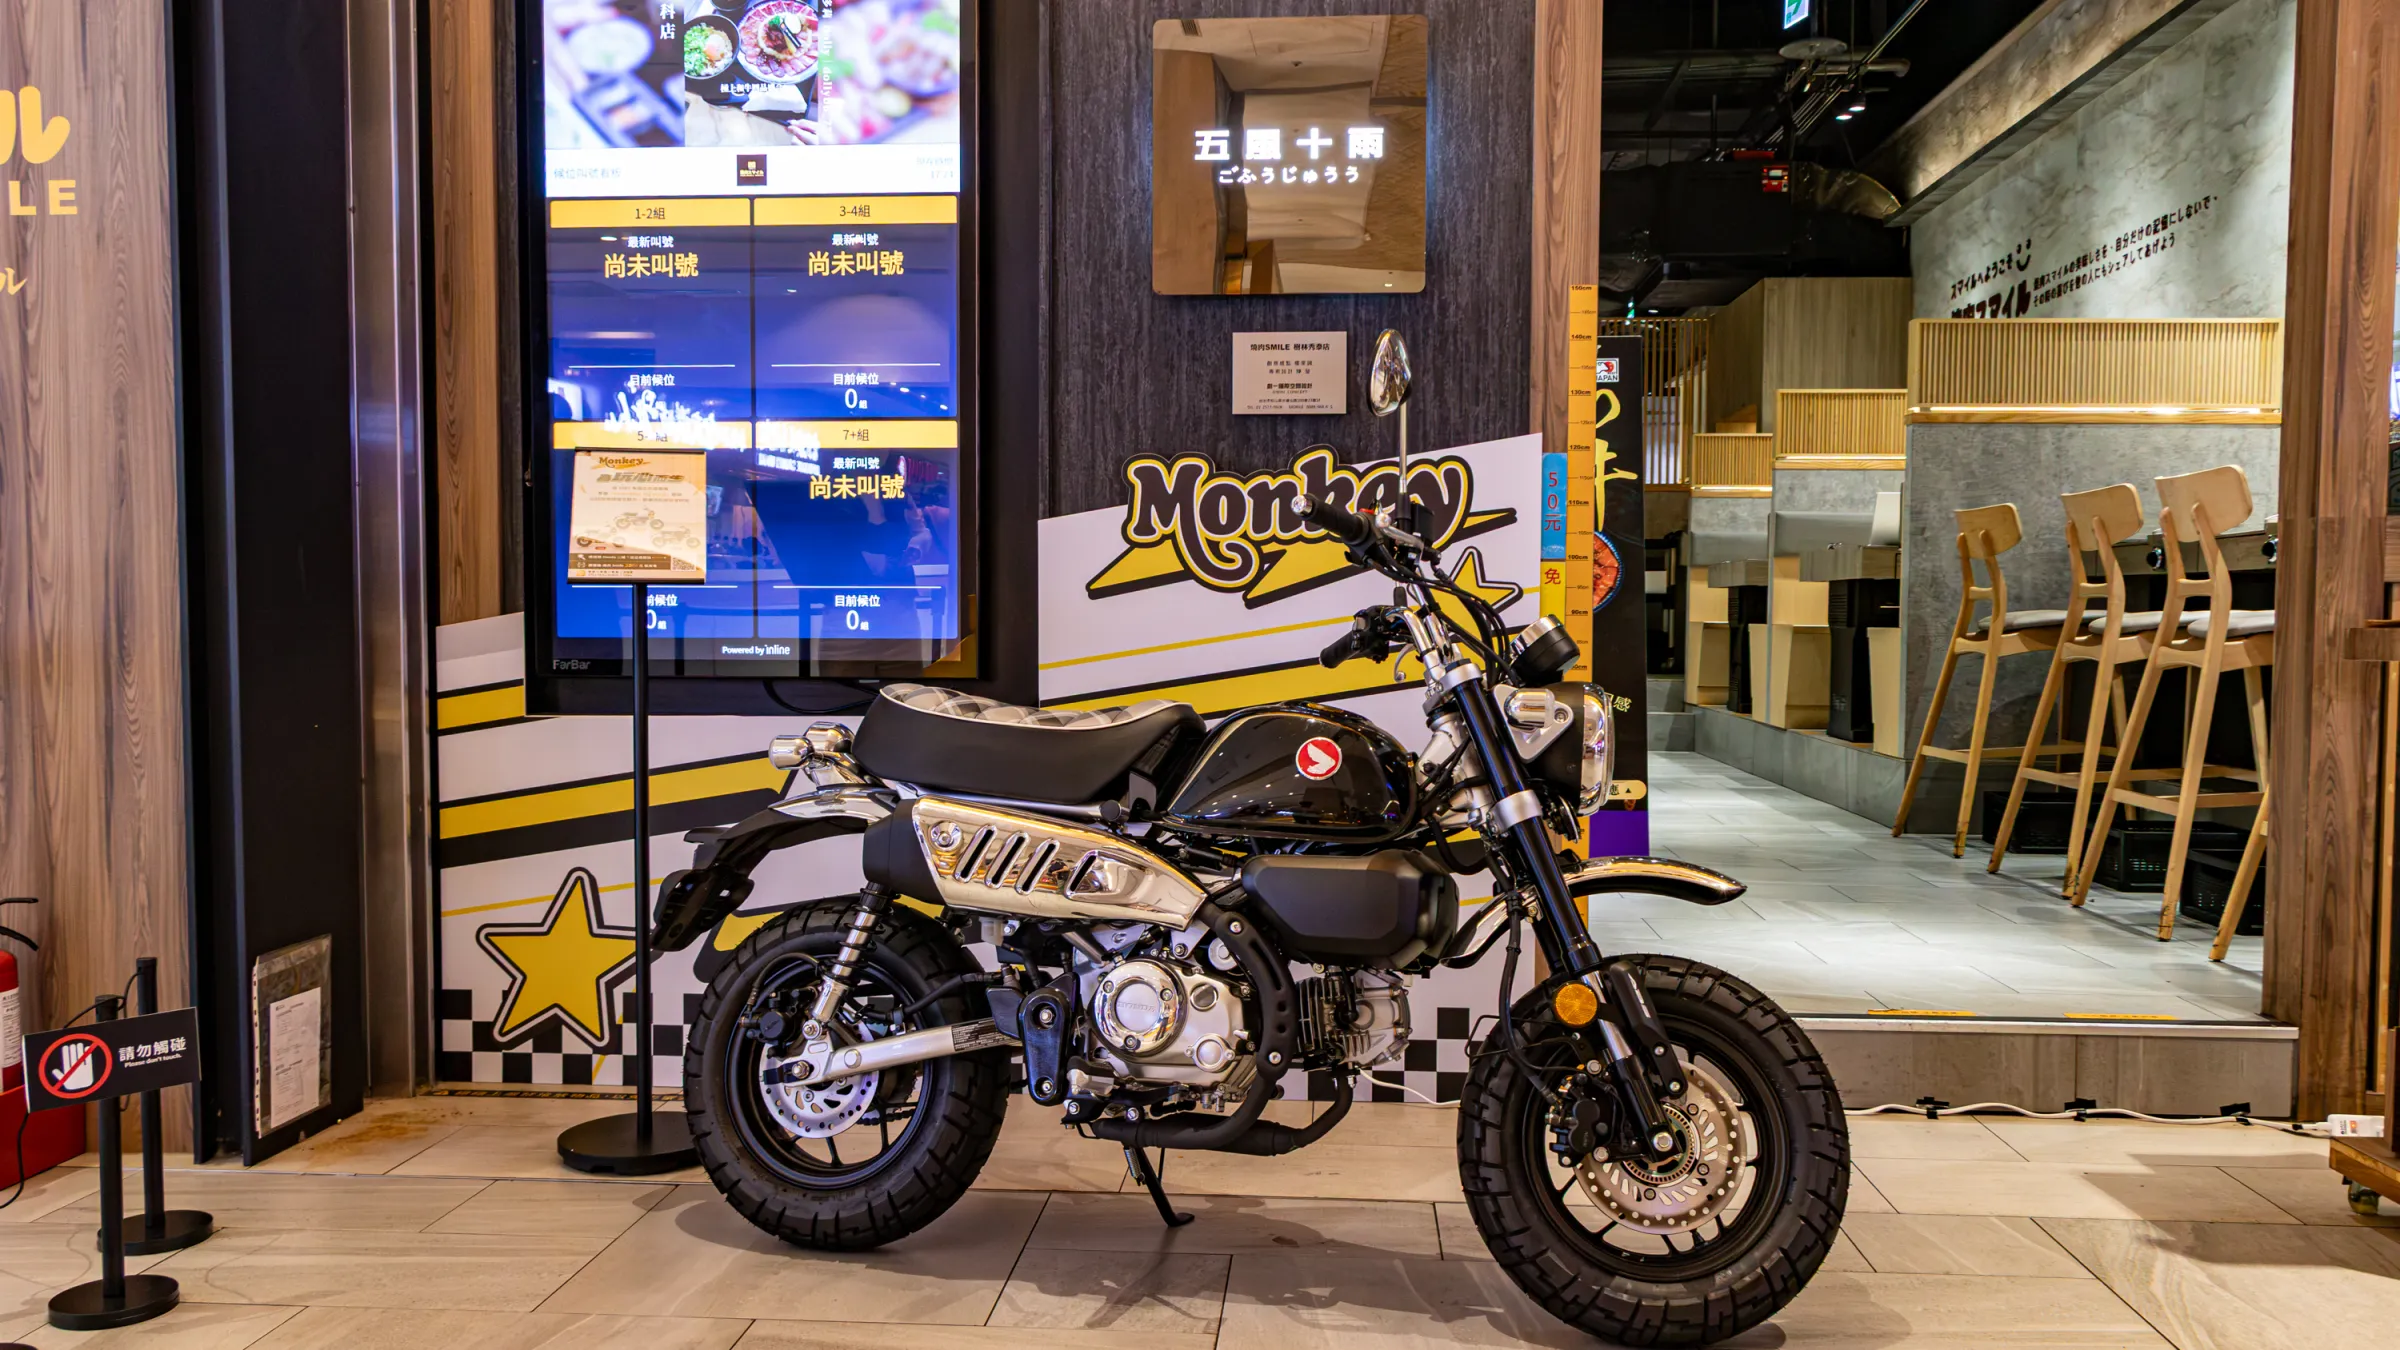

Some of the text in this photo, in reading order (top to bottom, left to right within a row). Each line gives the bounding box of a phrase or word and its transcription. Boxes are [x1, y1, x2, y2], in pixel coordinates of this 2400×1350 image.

[1194, 126, 1385, 161] 五風十雨
[1218, 165, 1360, 184] ごふうじゅうう
[635, 207, 666, 220] 1-2組
[839, 205, 871, 218] 3-4組
[628, 235, 674, 248] 最新叫號
[831, 233, 879, 246] 最新叫號
[604, 252, 699, 279] 尚未叫號
[808, 249, 905, 277] 尚未叫號
[629, 374, 675, 387] 目前候位
[833, 372, 879, 386] 目前候位
[842, 428, 870, 442] 7+組
[599, 457, 644, 468] Monkey
[833, 456, 880, 470] 最新叫號
[809, 473, 905, 500] 尚未叫號
[1124, 447, 1472, 590] Monkey
[1544, 567, 1561, 585] 免
[647, 593, 678, 606] 前候位
[834, 595, 881, 607] 目前候位
[722, 644, 790, 656] Powered by inline
[118, 1036, 187, 1062] 請勿觸碰
[124, 1060, 146, 1069] Please
[162, 1053, 182, 1061] touch.
